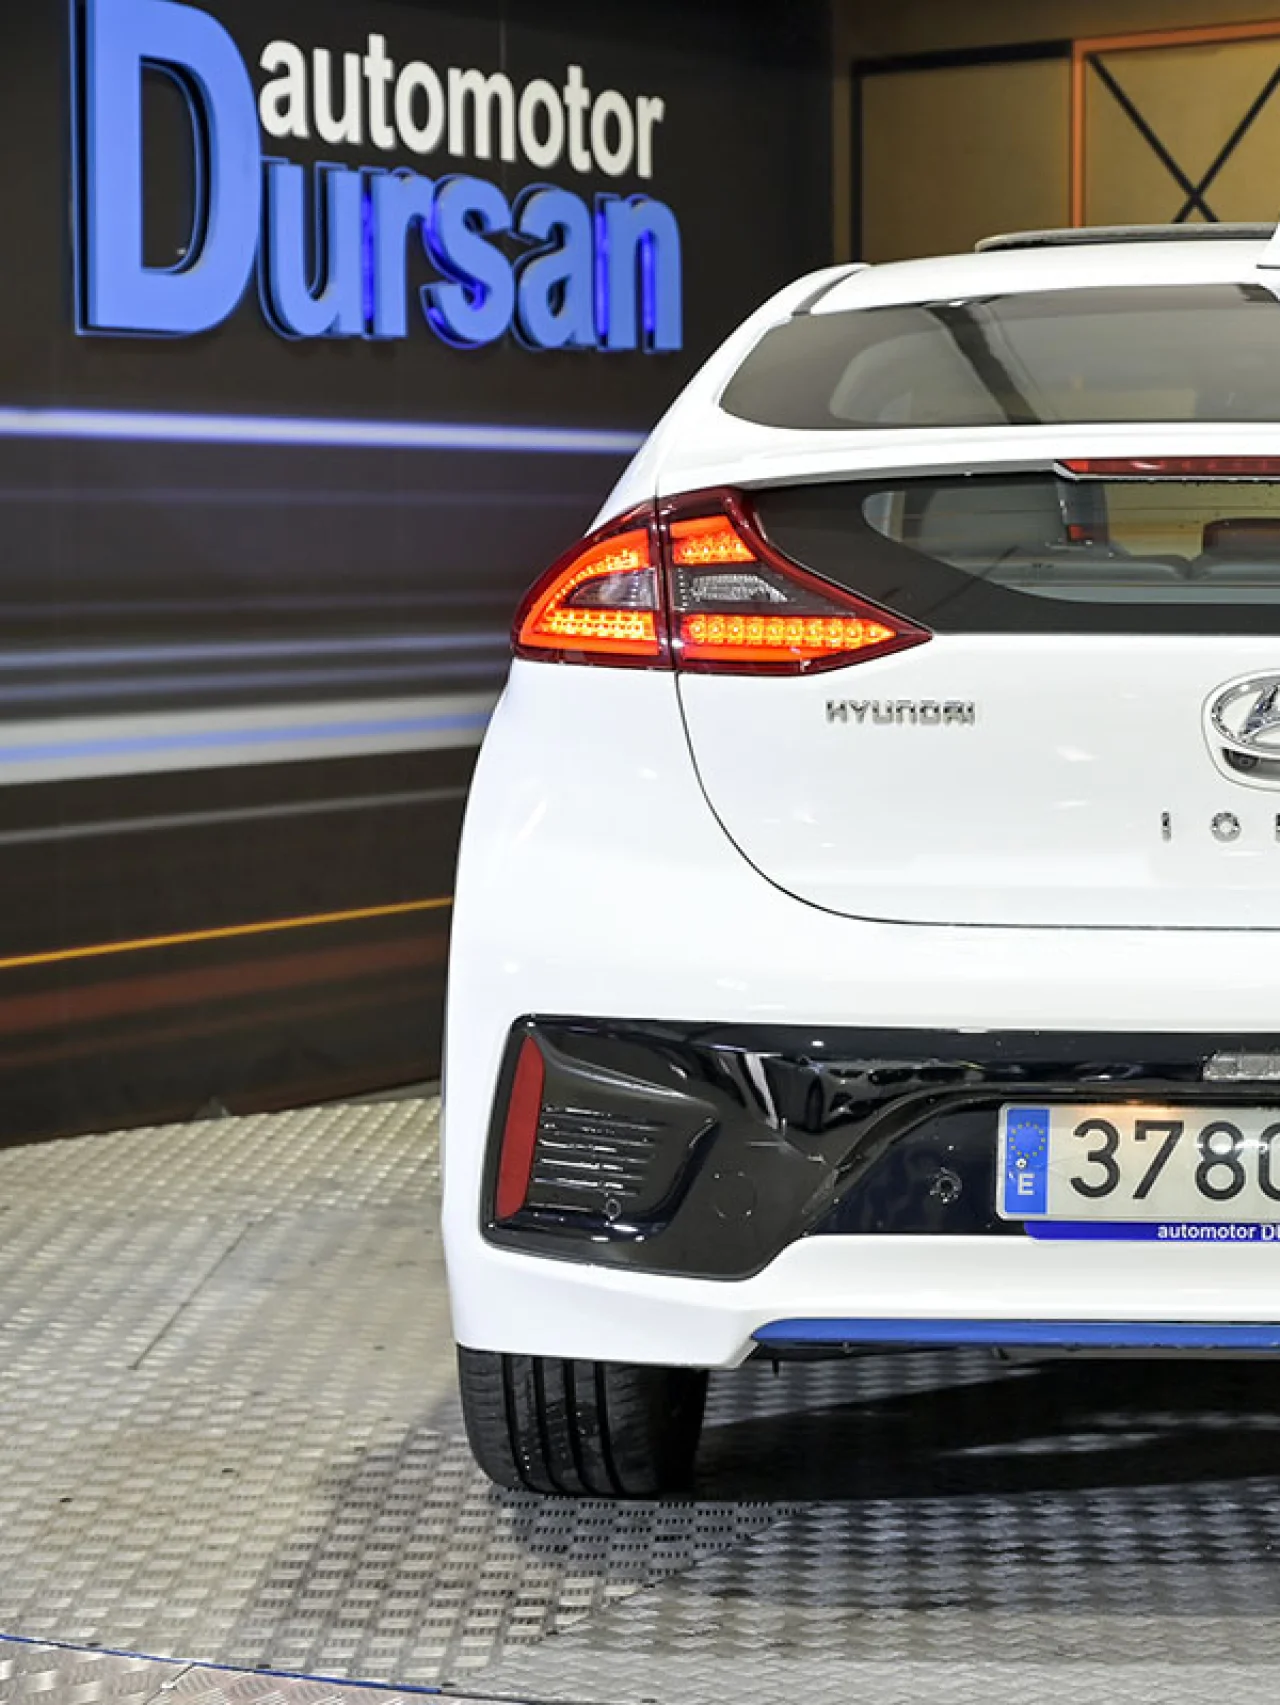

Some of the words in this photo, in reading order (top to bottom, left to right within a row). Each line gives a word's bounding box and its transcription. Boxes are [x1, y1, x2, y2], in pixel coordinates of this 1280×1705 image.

[260, 33, 664, 178] automotor
[72, 0, 682, 354] Dursan
[825, 699, 975, 724] HYUNDAI
[1017, 1173, 1036, 1196] E
[1157, 1224, 1257, 1239] automotor
